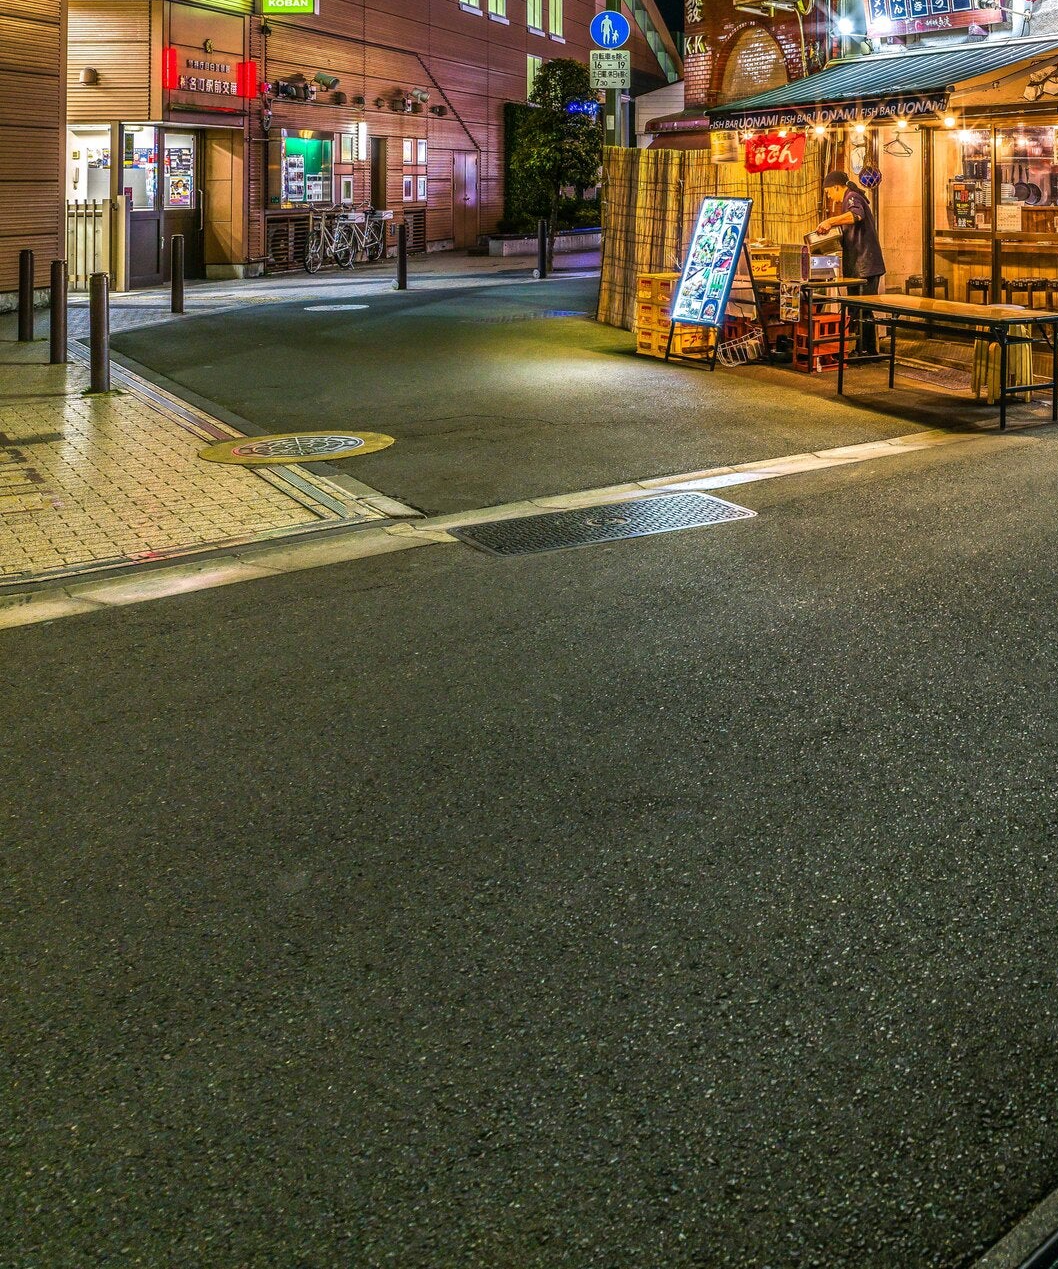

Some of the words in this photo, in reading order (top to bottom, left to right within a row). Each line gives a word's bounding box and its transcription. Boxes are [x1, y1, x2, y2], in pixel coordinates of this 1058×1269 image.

[268, 0, 309, 7] KOBAN
[594, 61, 602, 69] 16
[618, 61, 626, 69] 19
[725, 119, 739, 130] BAR
[738, 115, 778, 129] UONAMI
[780, 114, 796, 125] FISH
[796, 113, 812, 125] BAR
[812, 110, 859, 125] UONAMI
[860, 107, 879, 118] FISH
[879, 105, 896, 117] BAR
